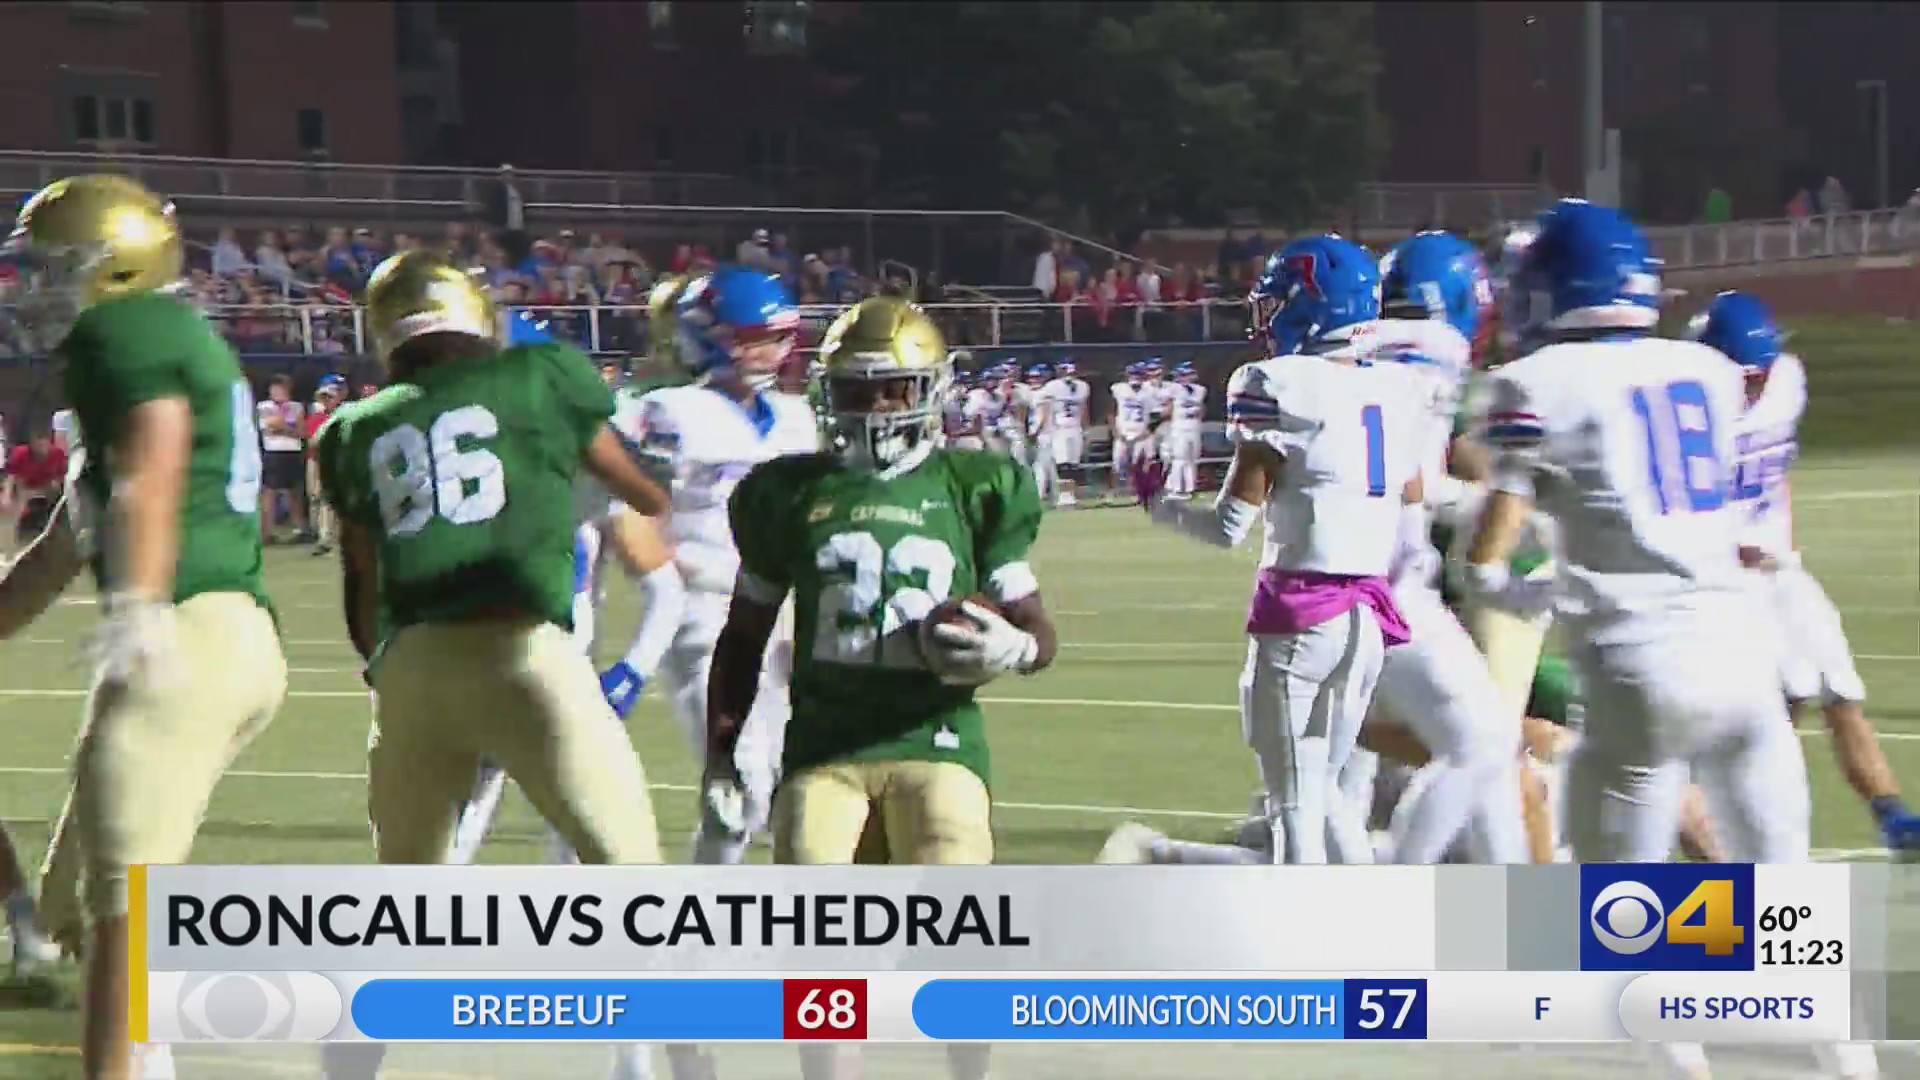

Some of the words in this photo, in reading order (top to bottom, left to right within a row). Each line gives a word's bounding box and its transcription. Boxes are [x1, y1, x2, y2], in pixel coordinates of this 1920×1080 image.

[369, 405, 506, 537] 86
[1360, 403, 1386, 498] 1
[1631, 380, 1727, 515] 18
[815, 532, 957, 668] 22
